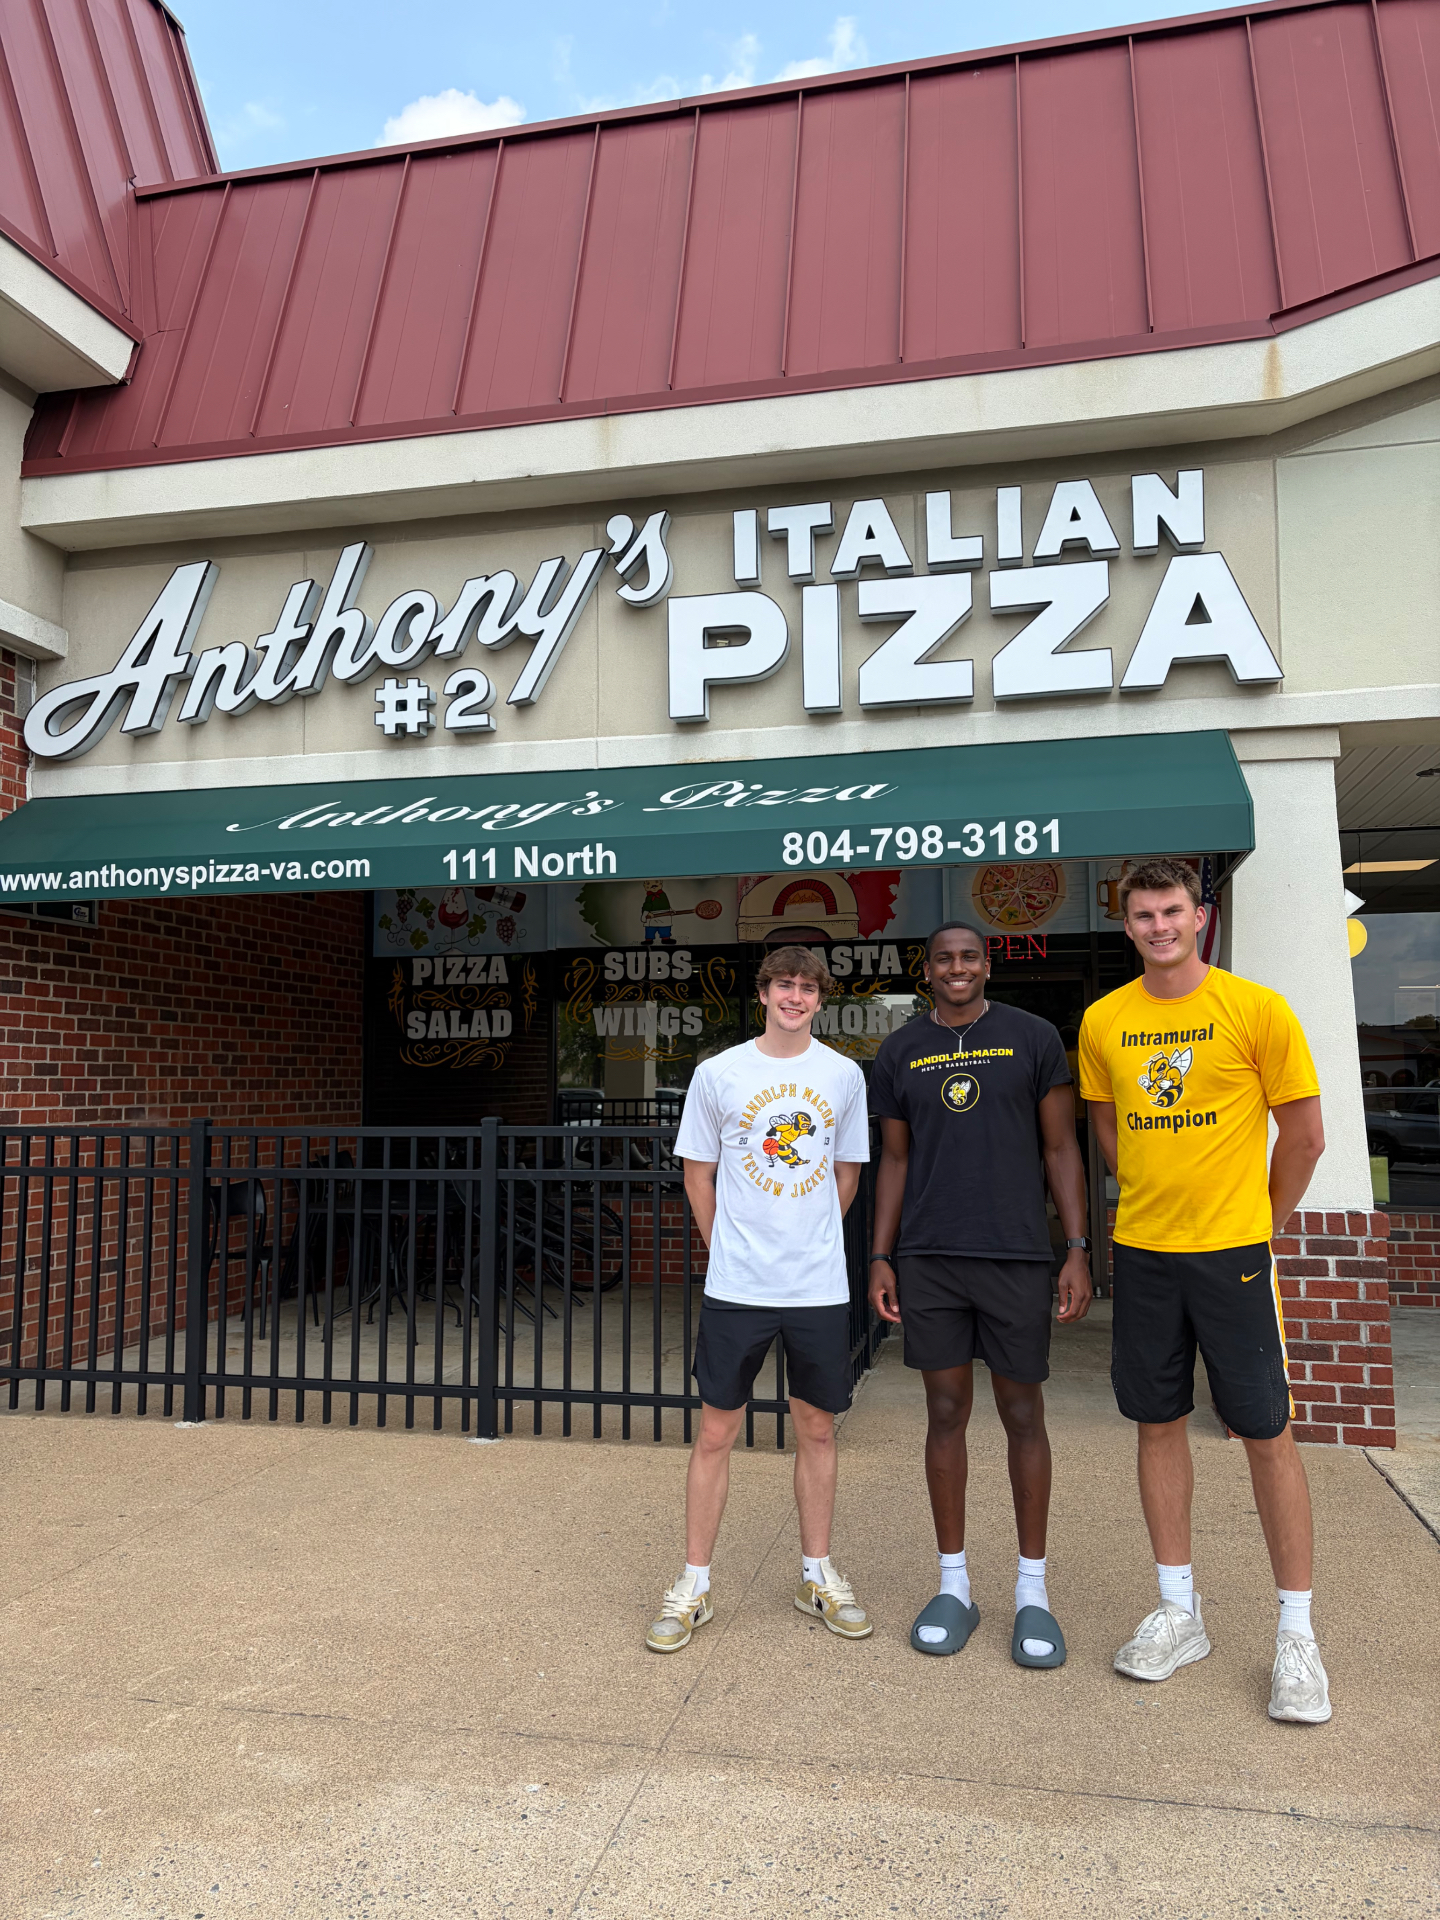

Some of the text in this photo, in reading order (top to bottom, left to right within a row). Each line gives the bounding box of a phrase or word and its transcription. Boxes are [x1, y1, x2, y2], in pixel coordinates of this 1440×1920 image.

[733, 468, 1206, 587] ITALIAN
[24, 509, 673, 760] Anthony's
[667, 550, 1285, 723] PIZZA
[374, 668, 497, 738] #2
[226, 779, 900, 832] Anthony's Pizza
[781, 818, 1061, 866] 804-798-3181
[0, 857, 371, 892] www.anthonyspizza-va.com
[442, 842, 617, 881] 111 North
[812, 944, 903, 977] ASTA
[986, 934, 1048, 960] PEN
[412, 956, 509, 986] PIZZA
[604, 950, 693, 981] SUBS
[406, 1009, 512, 1040] SALAD
[592, 1006, 703, 1037] WINGS
[811, 1004, 914, 1035] MORE
[1121, 1022, 1214, 1047] Intramural
[910, 1048, 1014, 1069] RANDOLPH-MACON
[921, 1058, 991, 1073] MEN'S BASKETBALL
[739, 1083, 835, 1130] RANDOLPH MACON
[1126, 1108, 1217, 1134] Champion
[738, 1137, 748, 1145] 20
[741, 1152, 785, 1197] YELLOW
